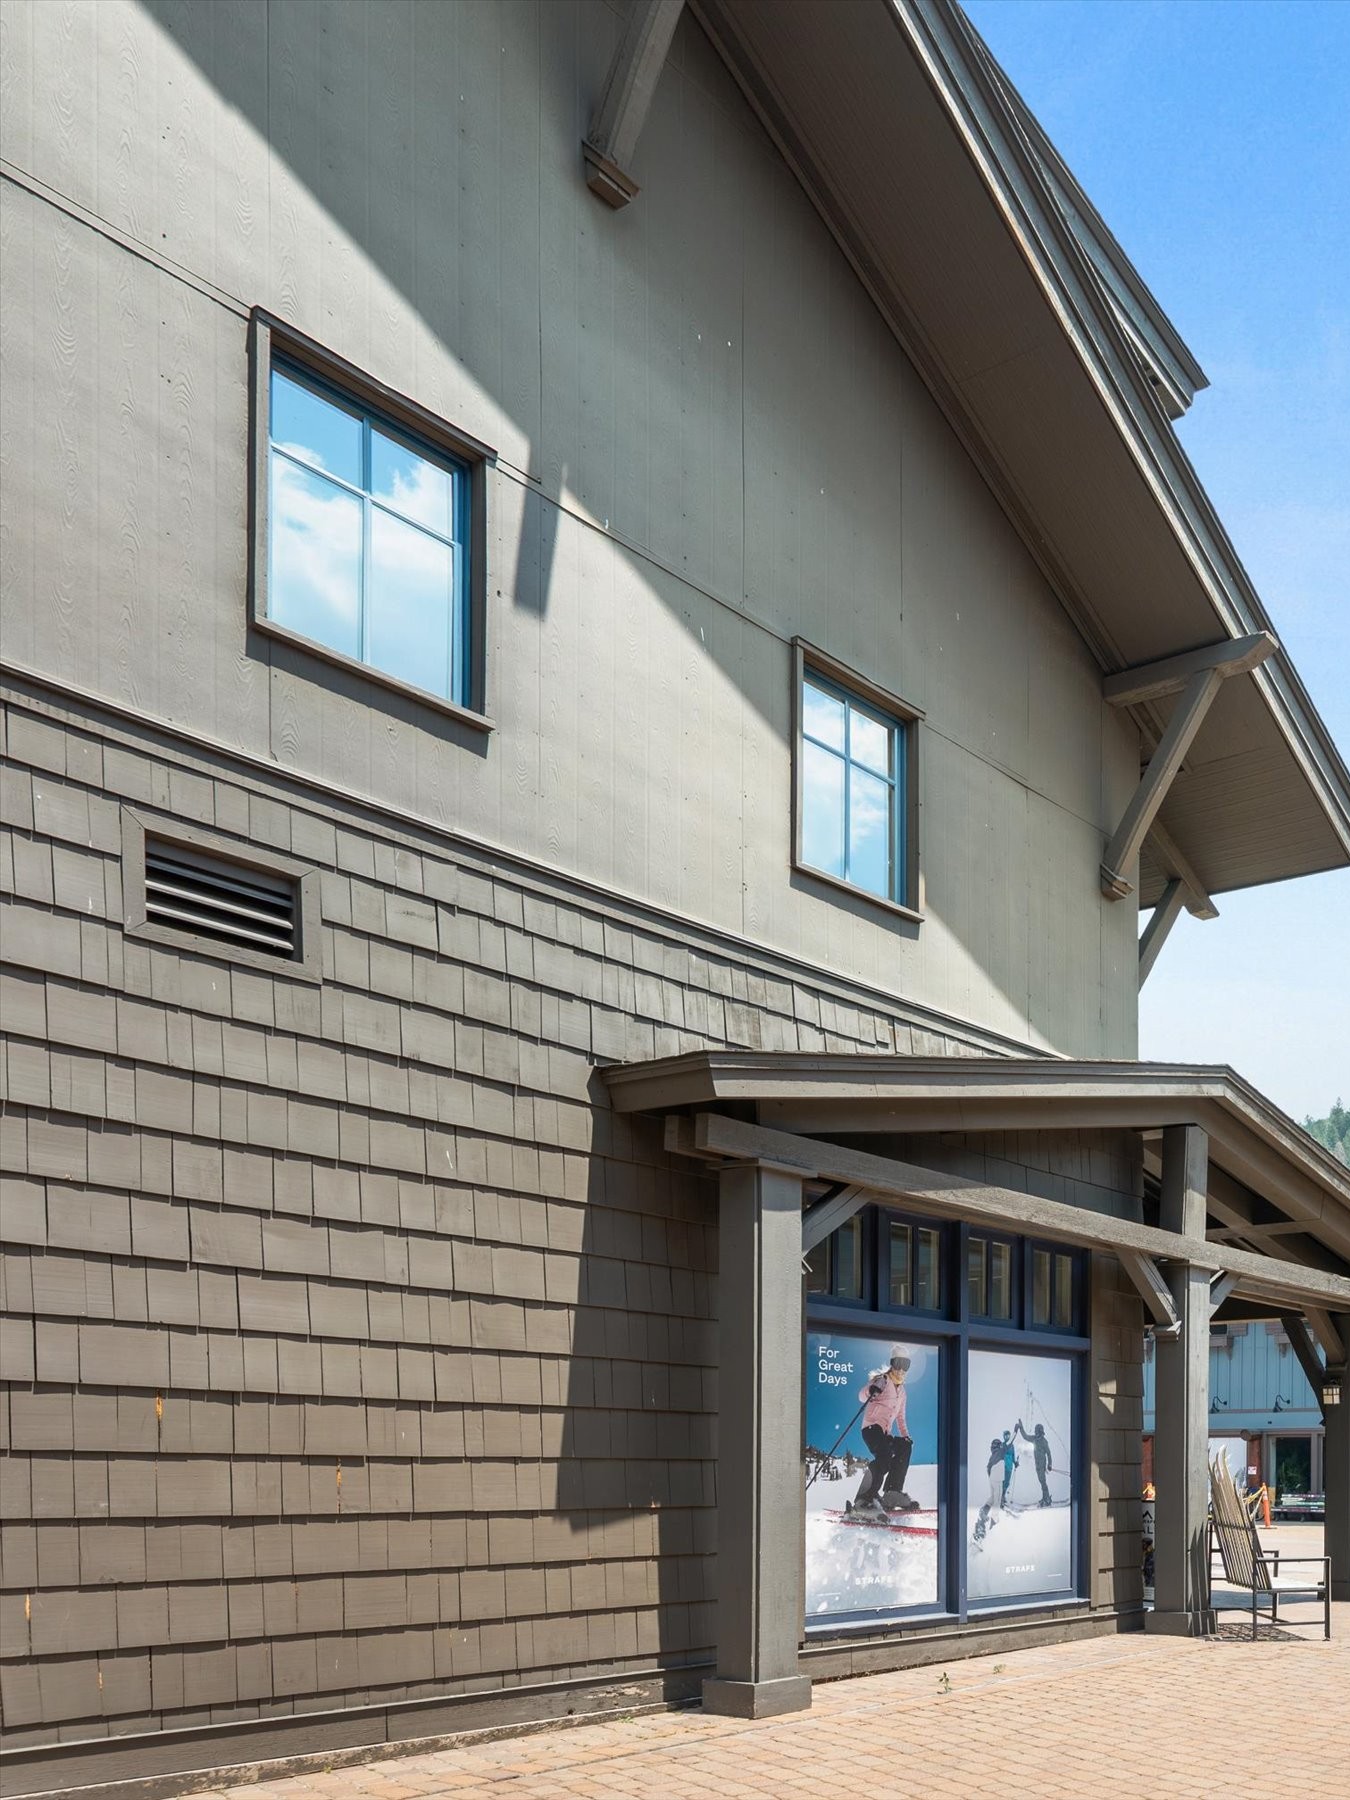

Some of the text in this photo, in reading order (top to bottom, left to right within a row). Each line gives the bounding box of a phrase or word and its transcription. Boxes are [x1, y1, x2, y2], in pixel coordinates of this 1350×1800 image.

[818, 1346, 840, 1358] For
[818, 1359, 854, 1373] Great
[818, 1372, 848, 1387] Days
